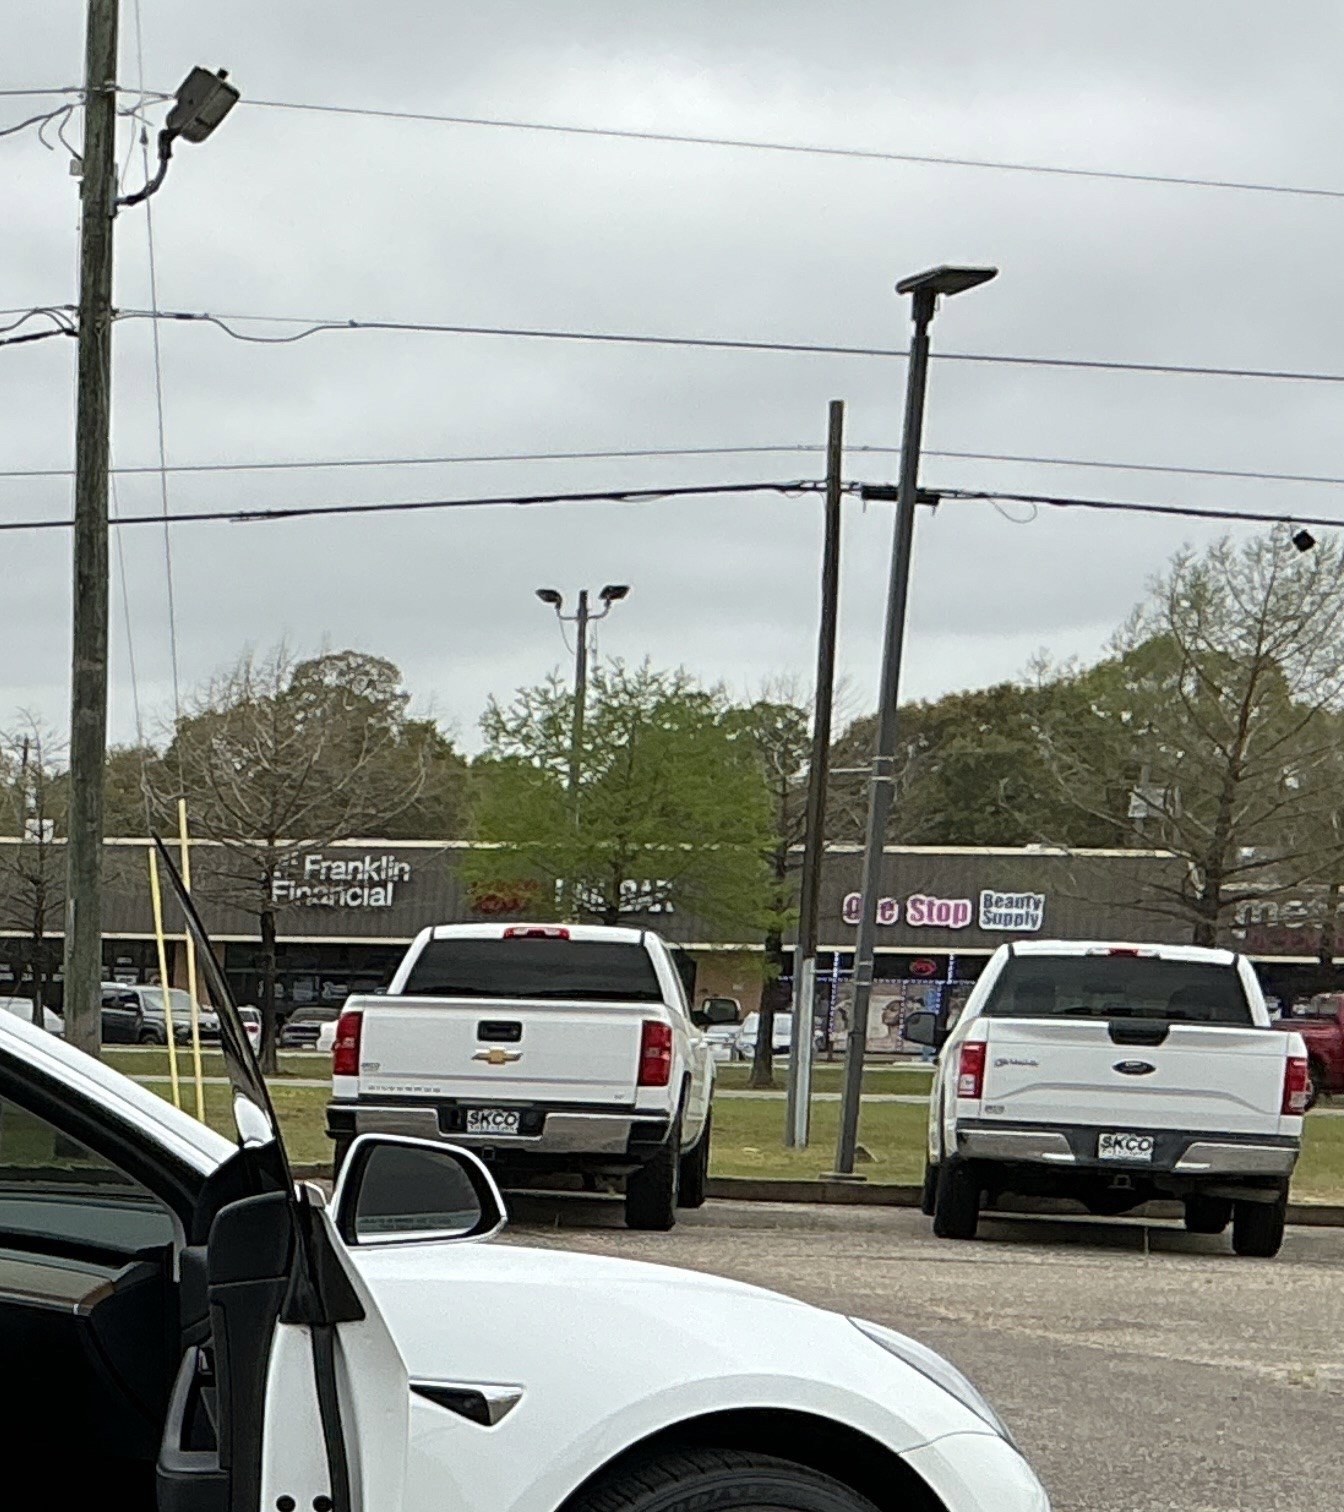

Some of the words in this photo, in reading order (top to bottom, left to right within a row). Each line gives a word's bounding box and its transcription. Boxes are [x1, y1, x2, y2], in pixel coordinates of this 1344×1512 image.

[303, 854, 413, 882] Franklin
[271, 880, 394, 907] Financial
[982, 893, 1043, 910] Beauty
[909, 896, 969, 925] Stop
[982, 911, 1040, 928] Supply
[468, 1111, 517, 1126] SKCO
[1100, 1135, 1151, 1151] SKCO
